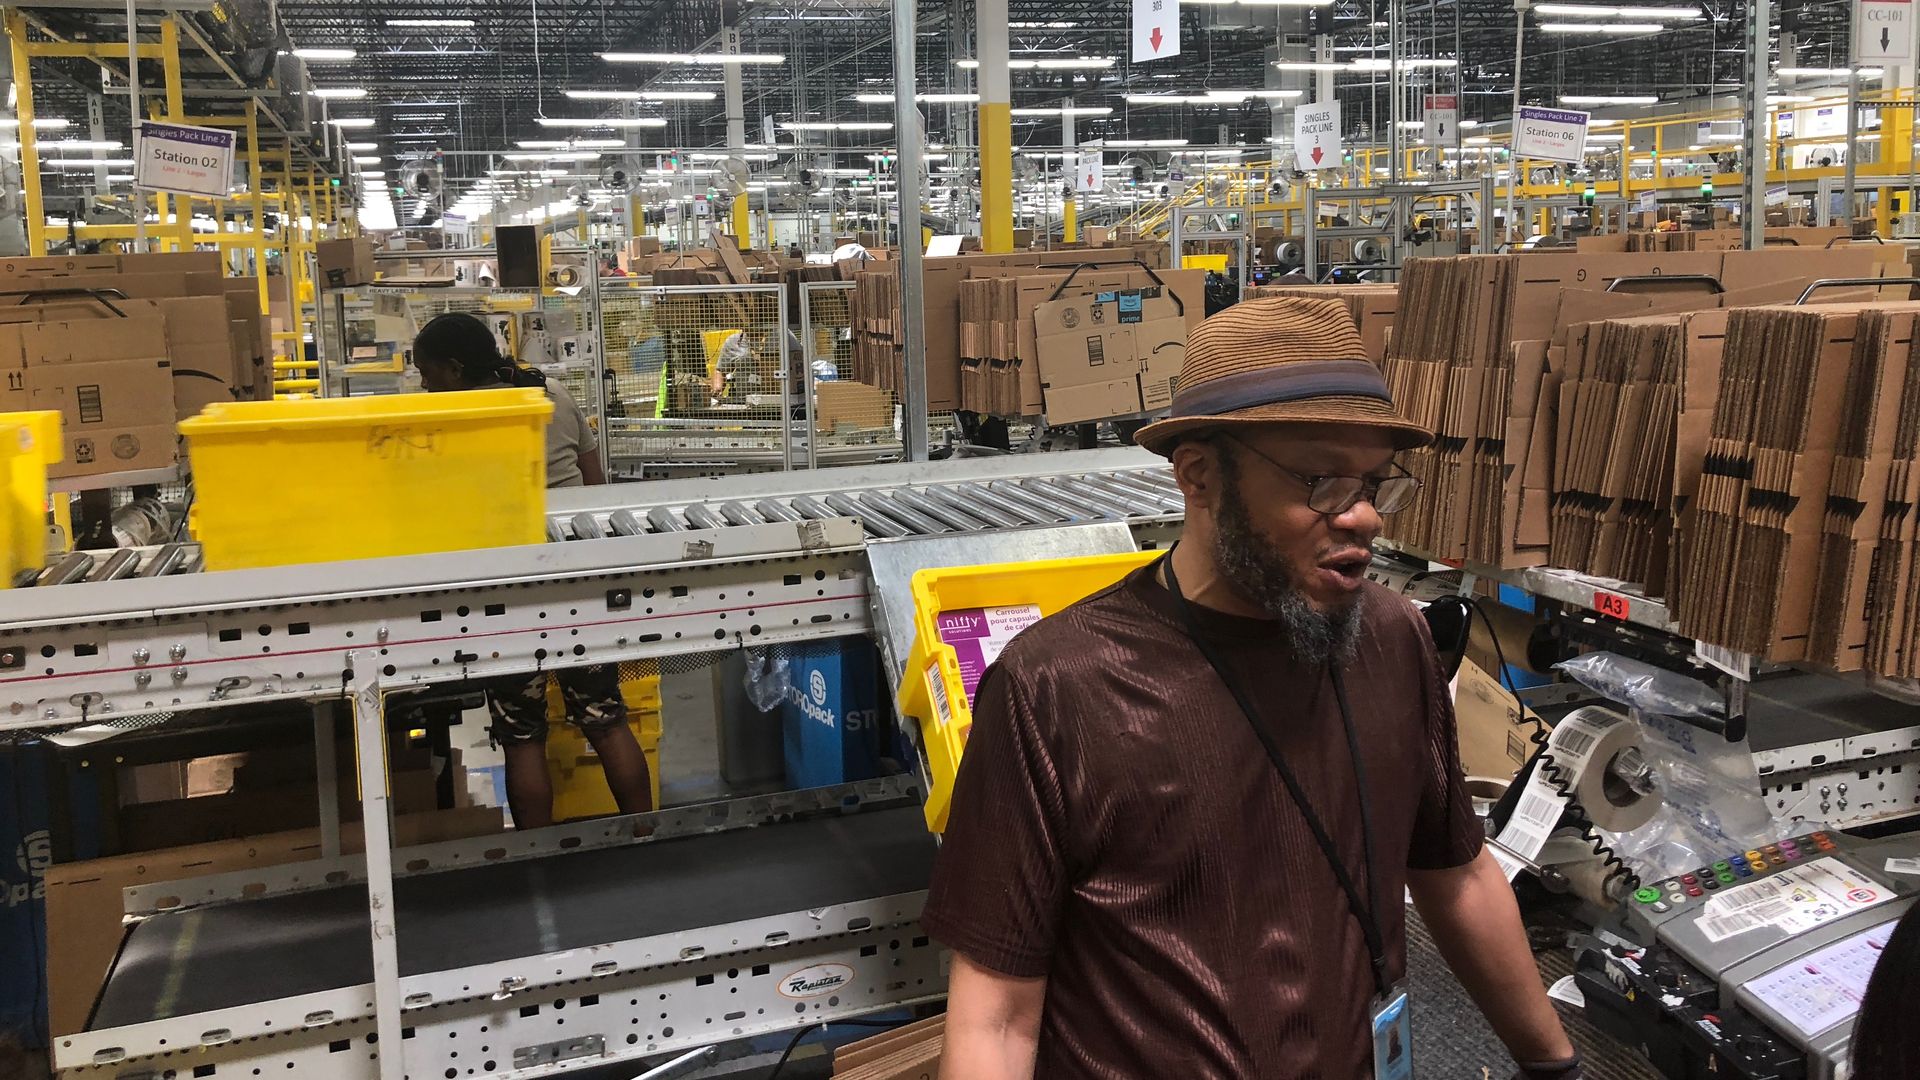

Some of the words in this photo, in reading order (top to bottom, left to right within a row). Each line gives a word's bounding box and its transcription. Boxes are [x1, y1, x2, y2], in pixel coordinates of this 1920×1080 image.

[1867, 9, 1903, 21] CC-101
[1304, 112, 1330, 123] SINGLES
[1525, 109, 1547, 119] Singles
[1548, 112, 1564, 121] Pack
[1564, 114, 1578, 122] Line
[1301, 124, 1318, 135] PACK
[1318, 122, 1334, 133] LINE
[1526, 126, 1560, 139] Station
[1562, 131, 1575, 141] 06
[179, 130, 199, 140] Pack
[201, 133, 218, 142] Line
[220, 136, 226, 144] 2
[1314, 135, 1319, 144] 3
[154, 148, 198, 166] Station
[201, 156, 218, 169] 02
[1121, 314, 1140, 323] prime
[995, 607, 1030, 616] Carrousel
[1602, 595, 1622, 615] A3
[946, 615, 978, 628] nifty
[990, 617, 1008, 626] pour
[1009, 614, 1040, 624] capsules
[789, 975, 845, 993] Rapistan
